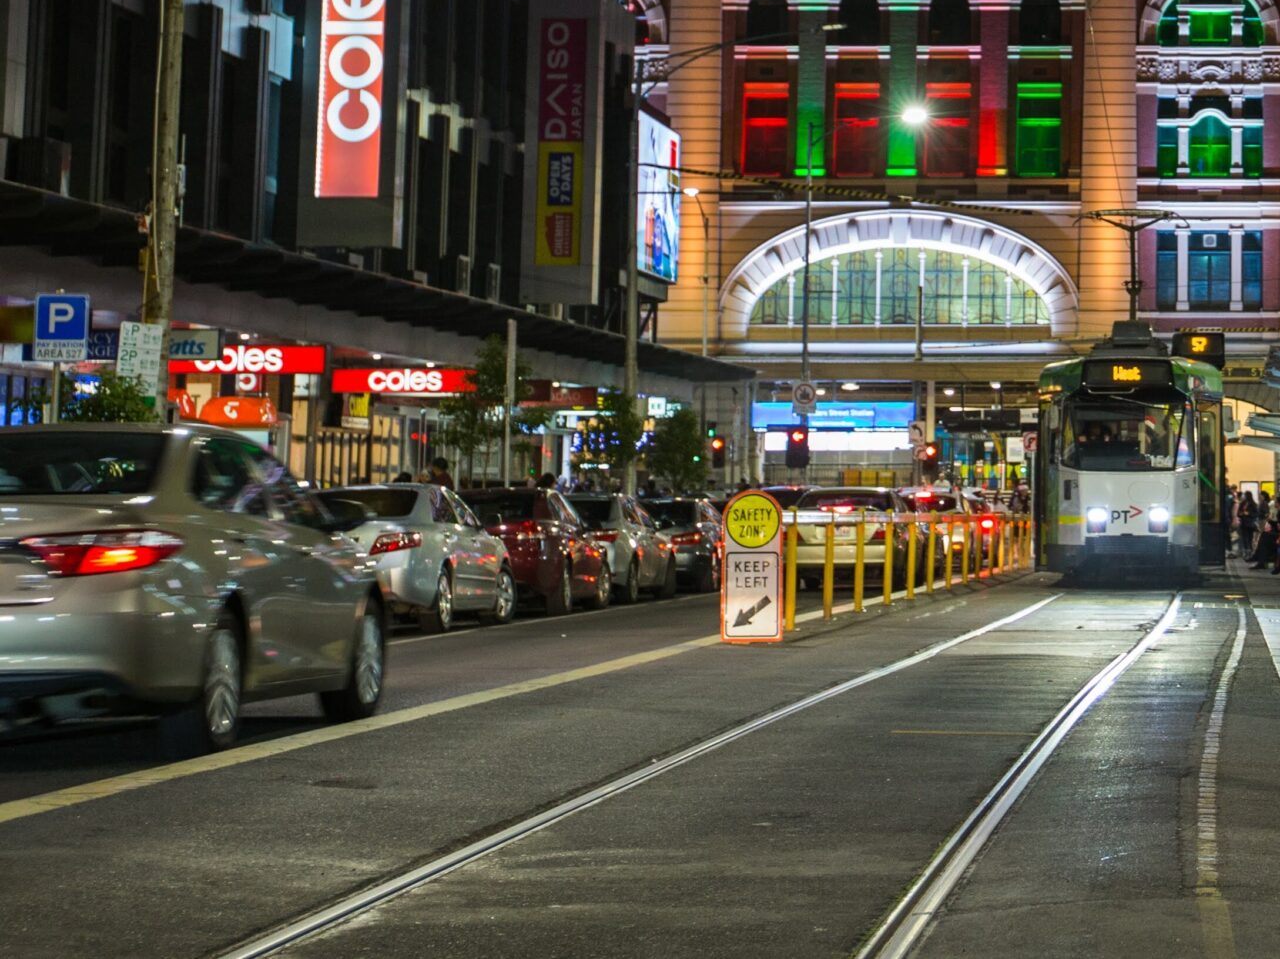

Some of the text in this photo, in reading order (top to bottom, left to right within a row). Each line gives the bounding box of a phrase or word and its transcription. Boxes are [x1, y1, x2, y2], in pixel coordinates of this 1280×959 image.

[544, 21, 570, 139] DAISO
[570, 82, 583, 138] JAPAN
[549, 159, 561, 197] OPEN
[561, 154, 573, 190] DAYS
[48, 302, 75, 334] P
[36, 349, 63, 359] AREA
[120, 349, 138, 361] 2P
[169, 338, 207, 356] atts
[367, 368, 444, 392] coles
[733, 508, 772, 522] SAFETY
[738, 525, 767, 538] ZONE
[734, 561, 770, 573] KEEP
[735, 576, 769, 589] LEFT
